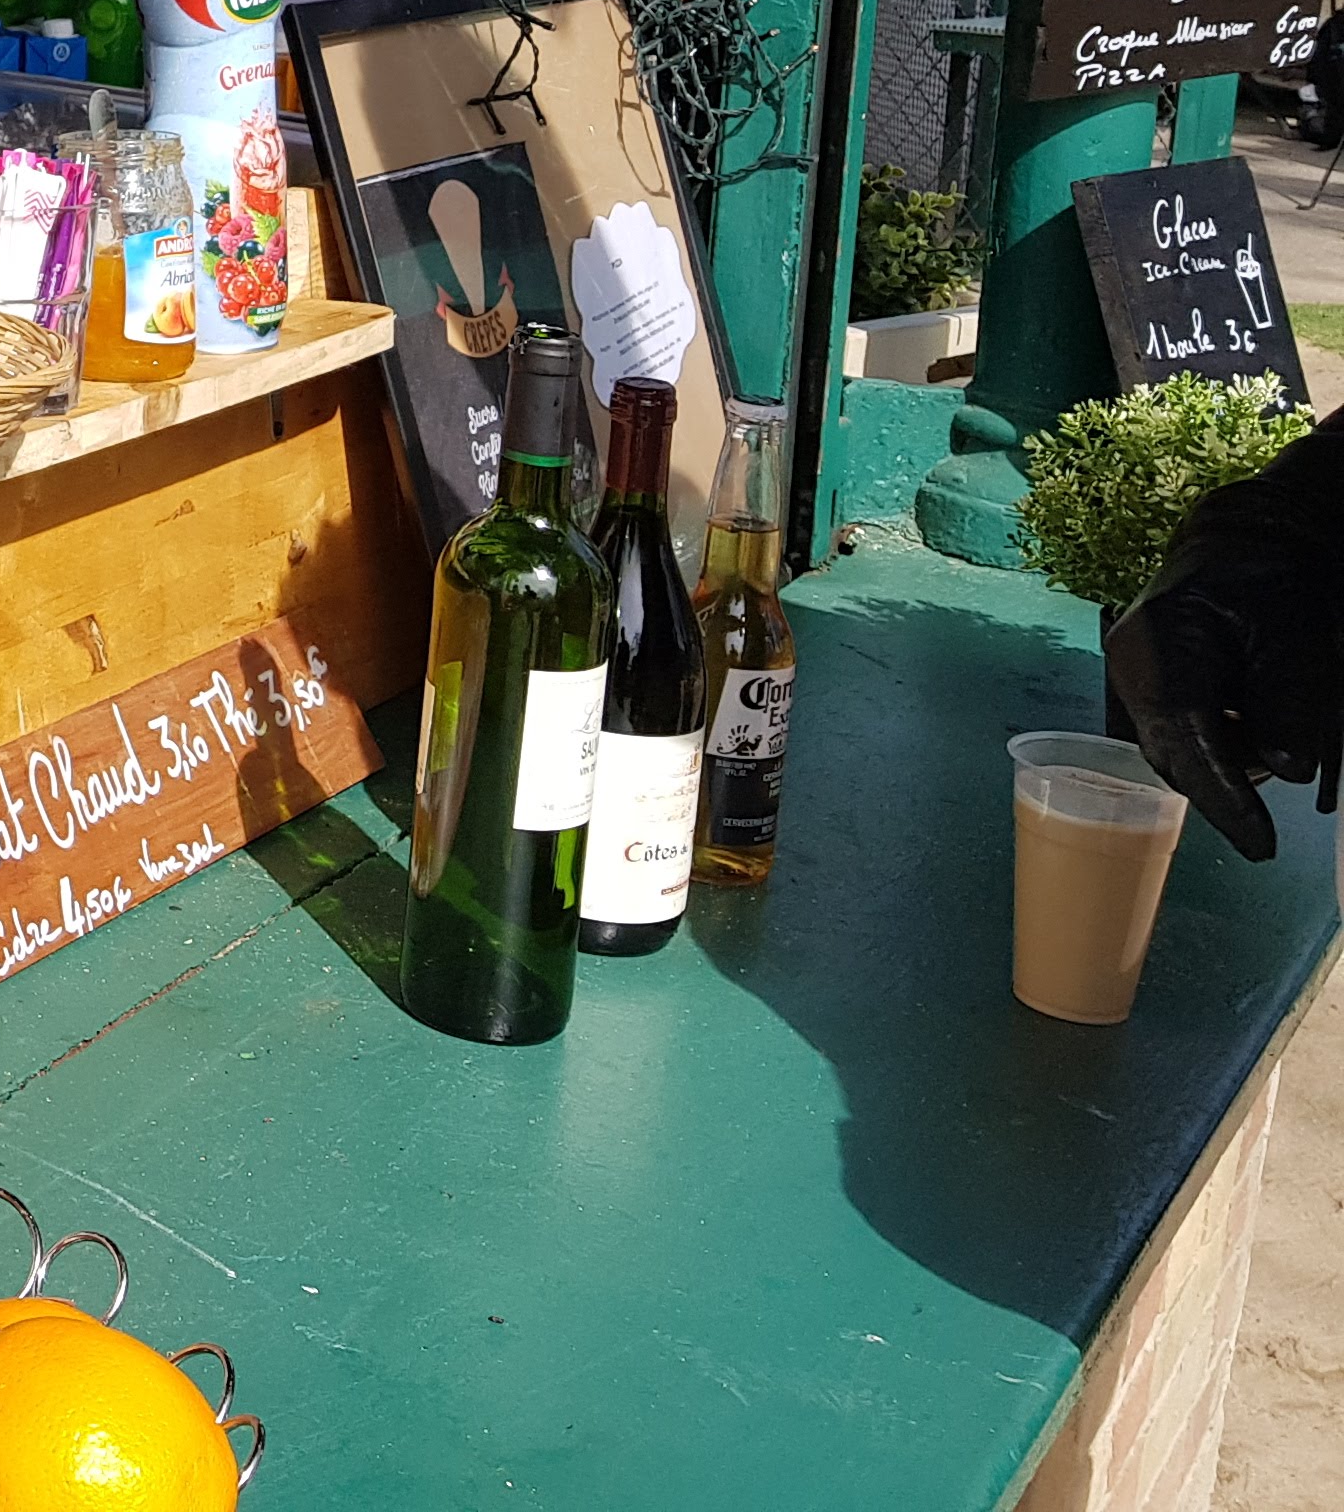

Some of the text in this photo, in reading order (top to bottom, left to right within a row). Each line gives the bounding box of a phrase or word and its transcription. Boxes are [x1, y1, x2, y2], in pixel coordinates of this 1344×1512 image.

[1076, 25, 1160, 68] Croque
[1275, 5, 1319, 34] 6,00
[1269, 35, 1316, 68] 6,50
[1152, 193, 1219, 249] Glaces
[463, 310, 507, 354] CREPES
[467, 404, 498, 435] Sucre
[27, 703, 161, 848] Chaud
[189, 670, 269, 753] Thé
